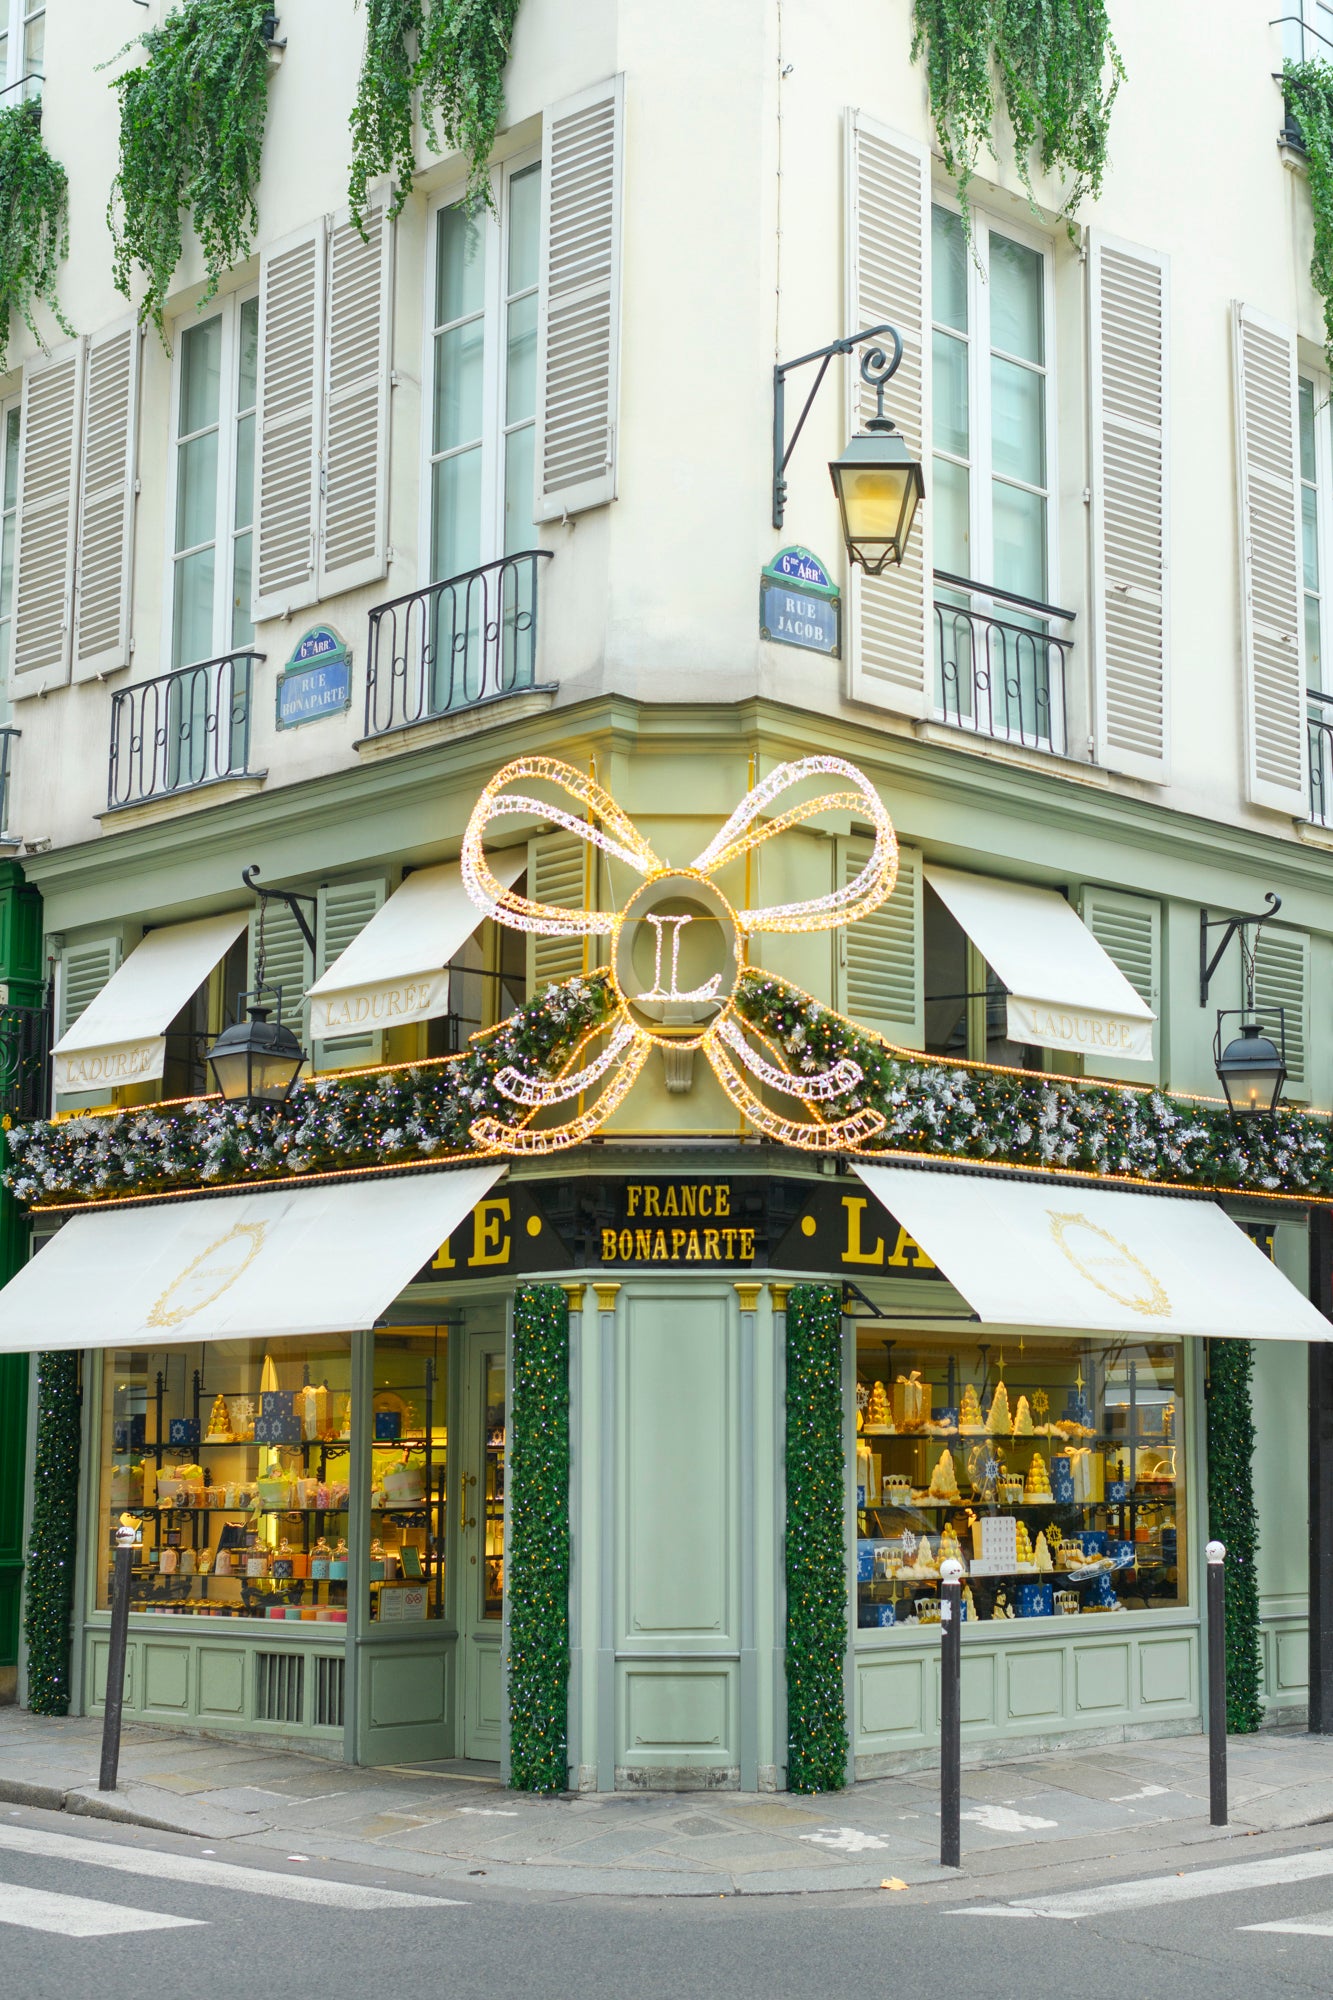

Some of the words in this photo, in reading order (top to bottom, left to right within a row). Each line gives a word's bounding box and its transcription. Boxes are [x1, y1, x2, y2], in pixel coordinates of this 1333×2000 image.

[786, 597, 816, 619] RUE
[302, 673, 326, 692] RUE
[283, 686, 345, 716] BONAPARTE
[637, 913, 723, 1002] L
[325, 983, 431, 1027] LADURÉE
[1031, 1008, 1135, 1049] LADURÉE
[66, 1048, 151, 1082] LADURÉE
[626, 1185, 731, 1217] FRANCE
[601, 1228, 755, 1261] BONAPARTE
